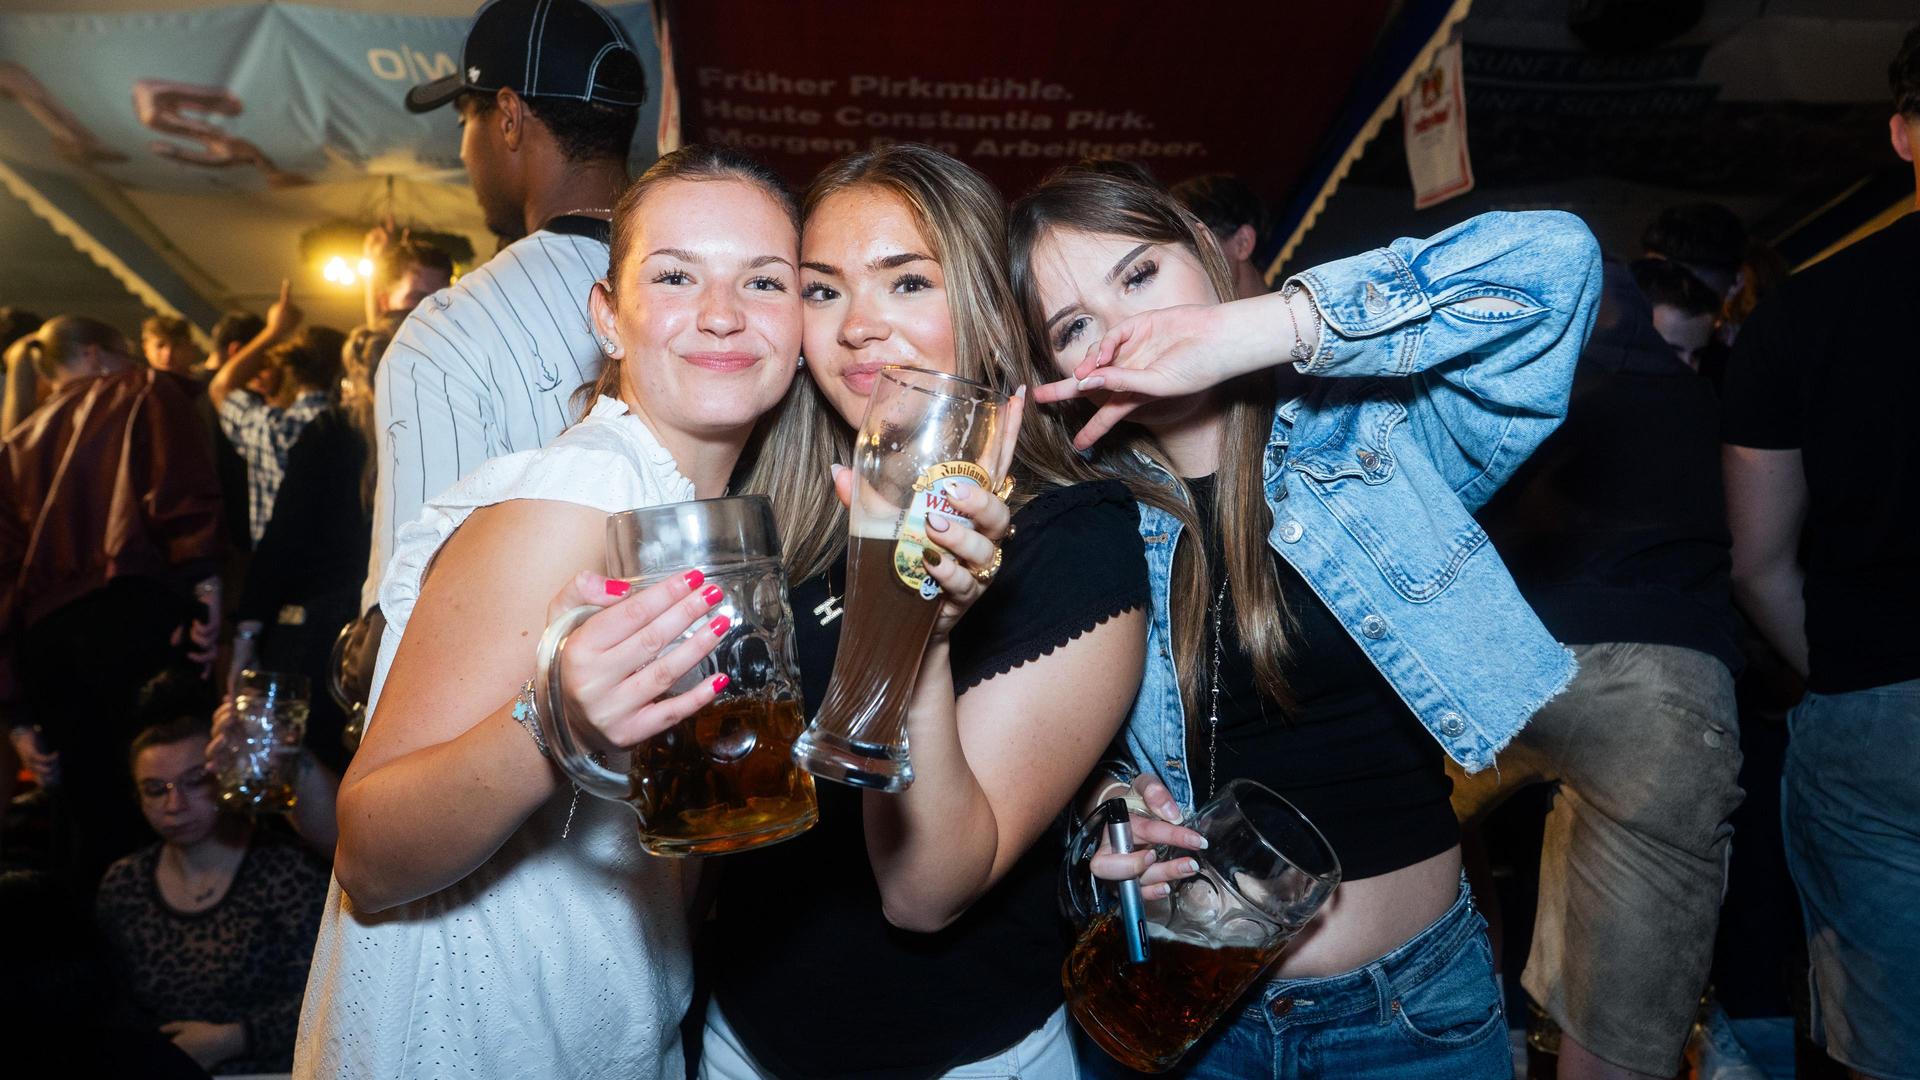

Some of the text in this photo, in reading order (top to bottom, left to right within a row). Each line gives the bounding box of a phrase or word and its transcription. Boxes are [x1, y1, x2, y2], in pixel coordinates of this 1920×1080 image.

[697, 68, 1074, 101] Früher Pirkmühle.
[701, 98, 1156, 131] Heute Constantia Pirk.
[705, 128, 857, 154] Morgen
[973, 137, 1208, 158] Arbeitgeber.
